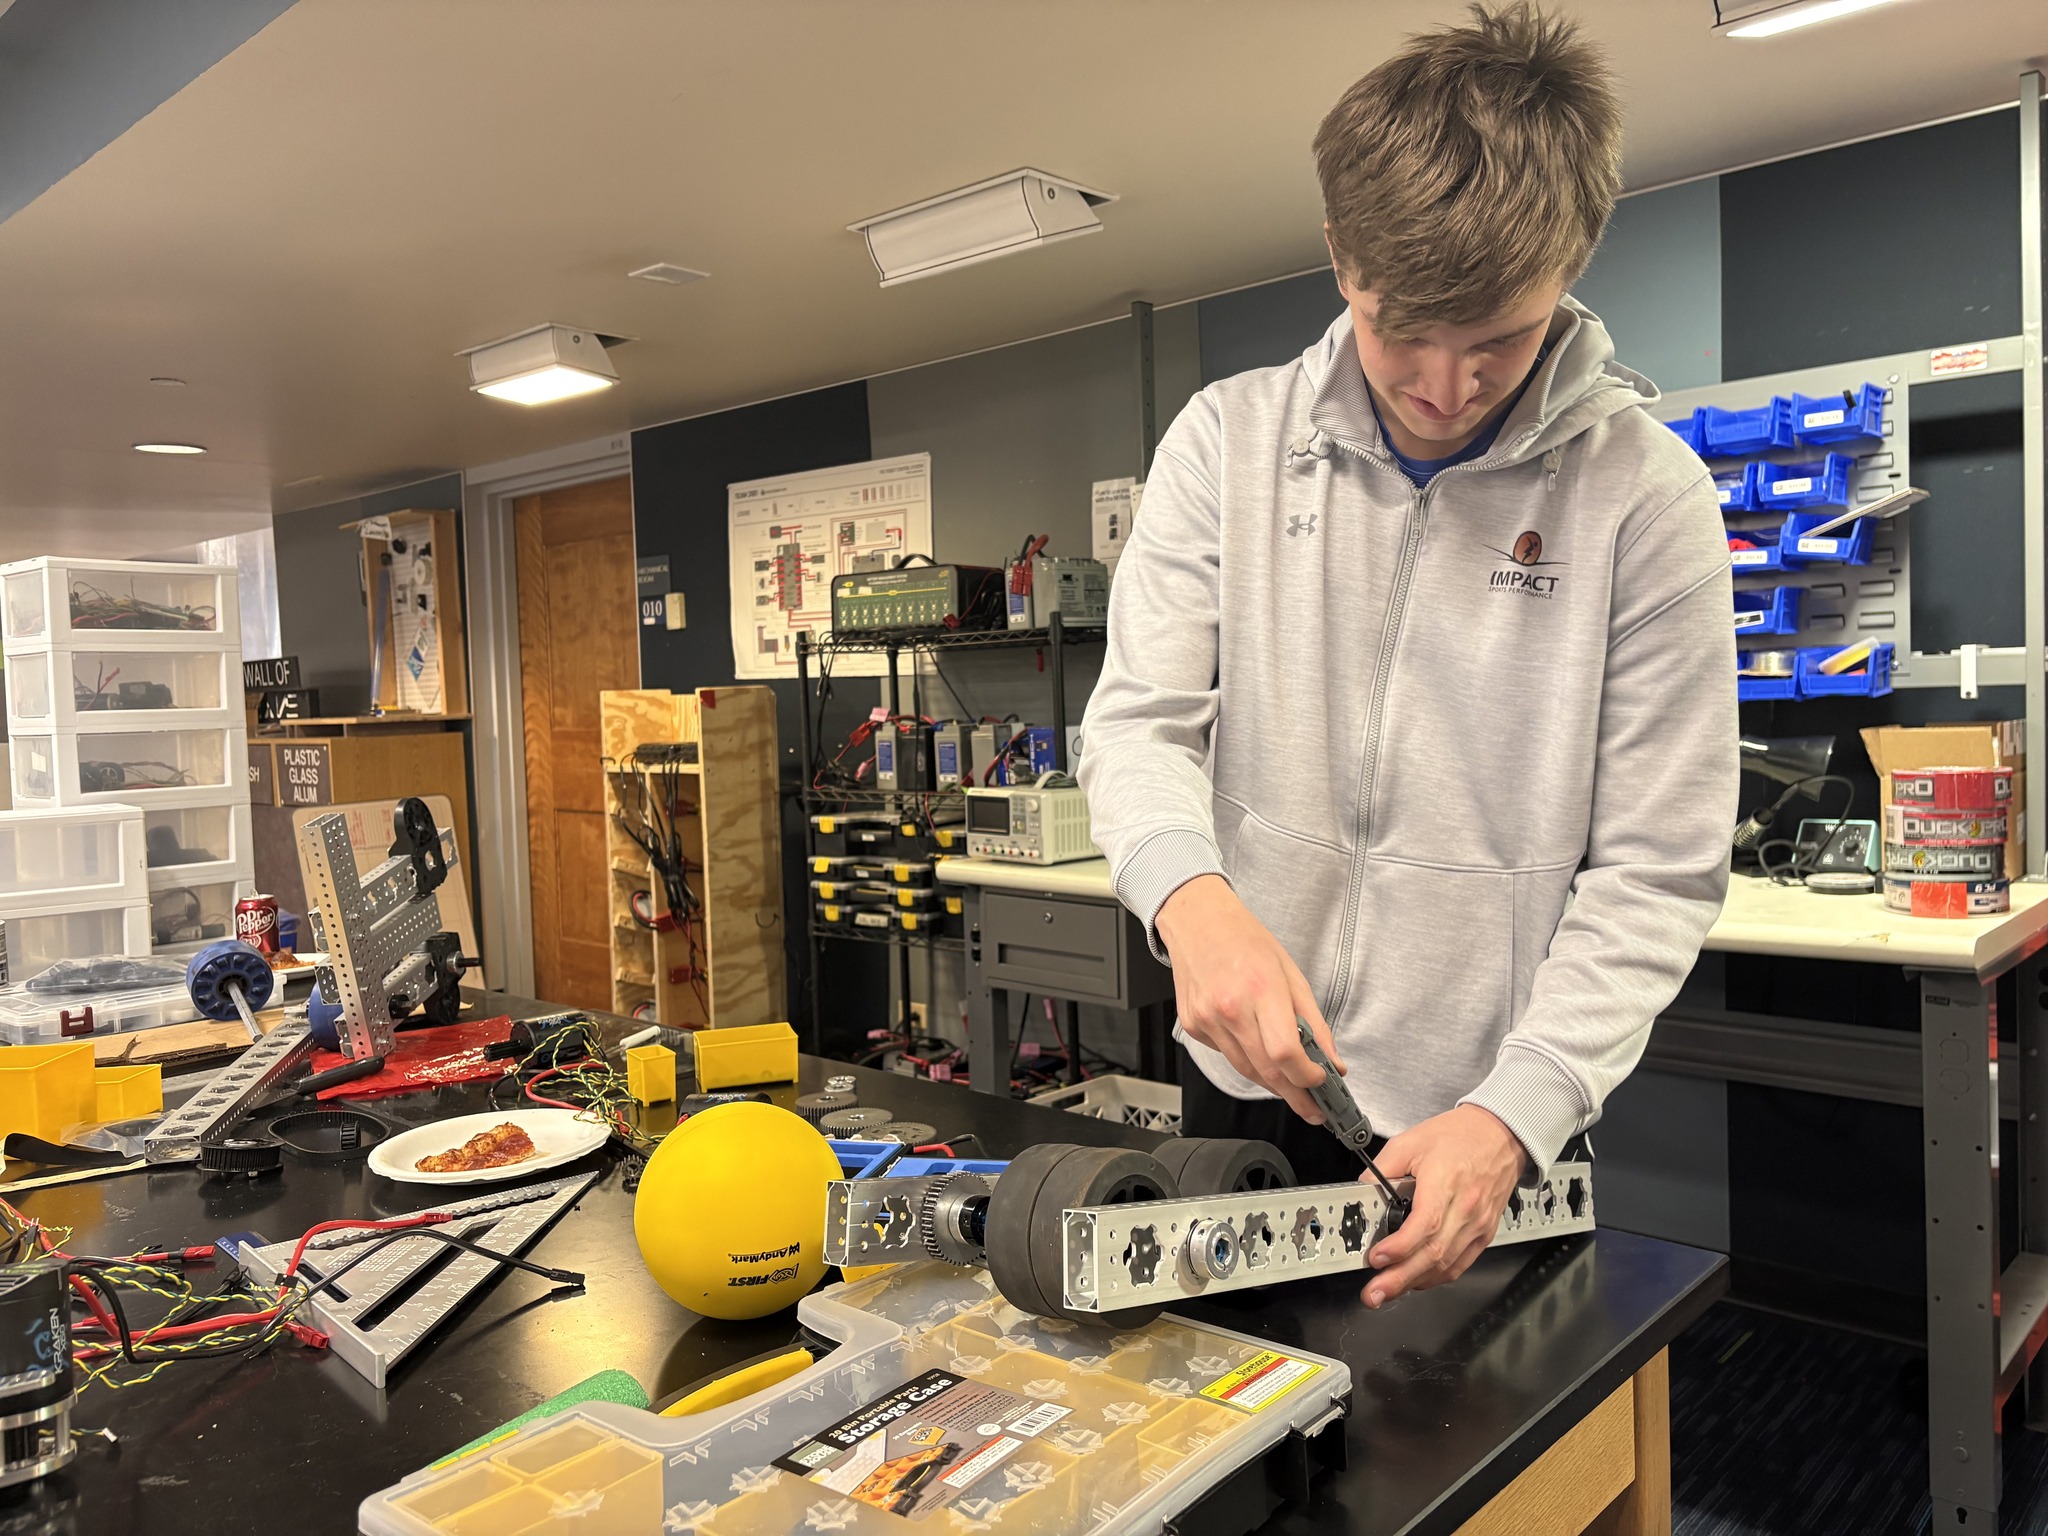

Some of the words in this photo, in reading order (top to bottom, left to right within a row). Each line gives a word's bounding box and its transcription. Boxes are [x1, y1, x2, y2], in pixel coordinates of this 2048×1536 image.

[1490, 571, 1559, 592] IMPACT
[1508, 587, 1553, 599] PERFORMANCE
[643, 600, 662, 617] 010
[243, 664, 273, 688] WALL
[275, 660, 290, 685] OF
[284, 749, 320, 766] PLASTIC
[289, 768, 319, 784] GLASS
[293, 786, 317, 803] ALUM
[1896, 779, 1933, 797] PRO
[1904, 818, 1969, 835] DUCK
[1925, 854, 1991, 870] DUCK
[237, 913, 273, 934] Pepper
[246, 910, 263, 922] Dr
[731, 1248, 788, 1264] AndyMark
[49, 1307, 64, 1374] KRAKEN
[829, 1428, 842, 1439] 20
[841, 1418, 859, 1432] Bin
[858, 1397, 897, 1422] Portable
[895, 1385, 919, 1400] Parts
[838, 1402, 912, 1444] Storage
[908, 1378, 952, 1402] Case
[799, 1445, 832, 1464] STORE
[803, 1447, 837, 1467] HOUSE
